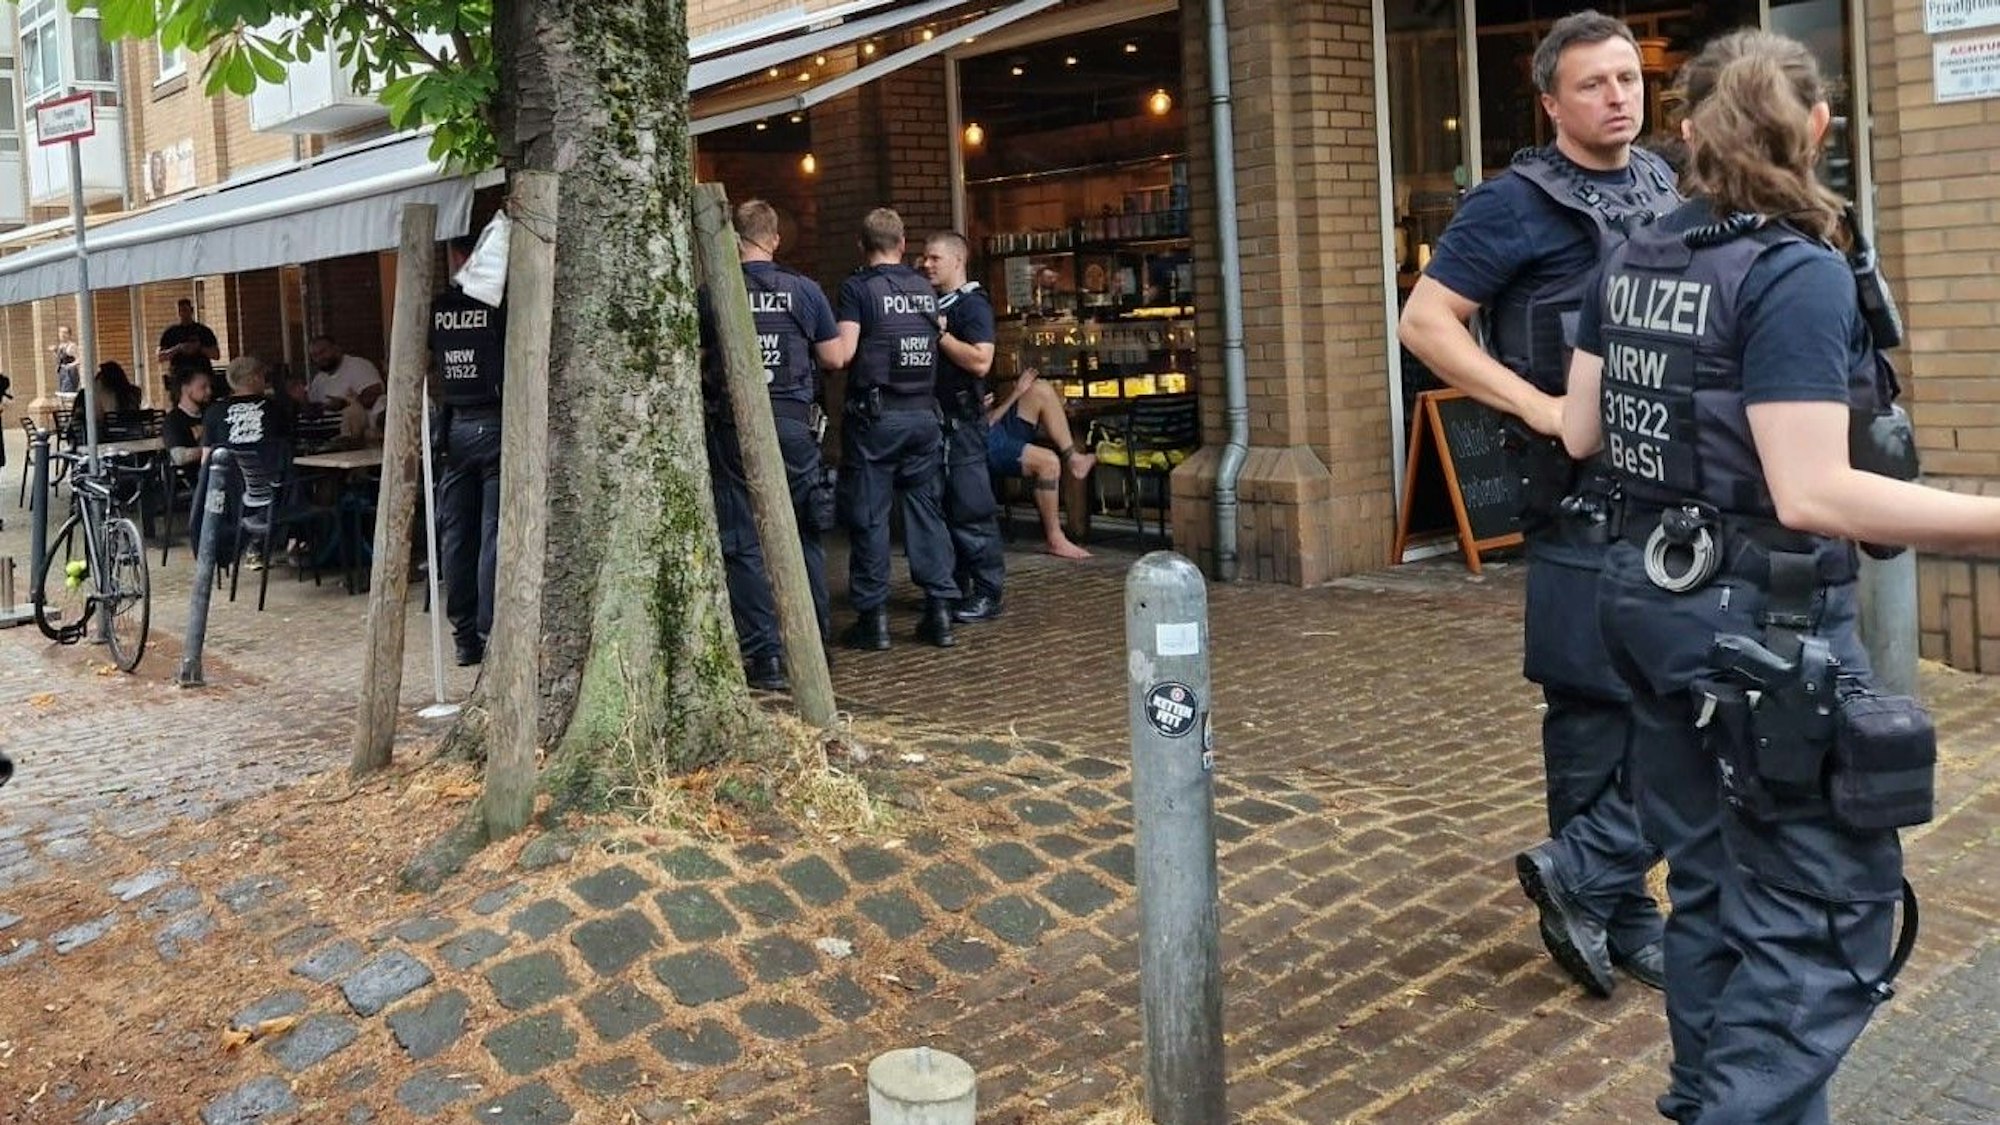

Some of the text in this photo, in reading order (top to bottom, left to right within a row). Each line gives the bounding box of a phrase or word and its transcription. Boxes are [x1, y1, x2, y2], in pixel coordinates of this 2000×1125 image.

[434, 309, 488, 331] POLIZEI
[900, 336, 929, 351] NRW
[444, 348, 475, 364] NRW
[900, 352, 932, 366] 31522
[1608, 341, 1668, 390] NRW
[444, 364, 478, 379] 31522
[1605, 390, 1671, 441] 31522
[1610, 432, 1665, 482] BeSi
